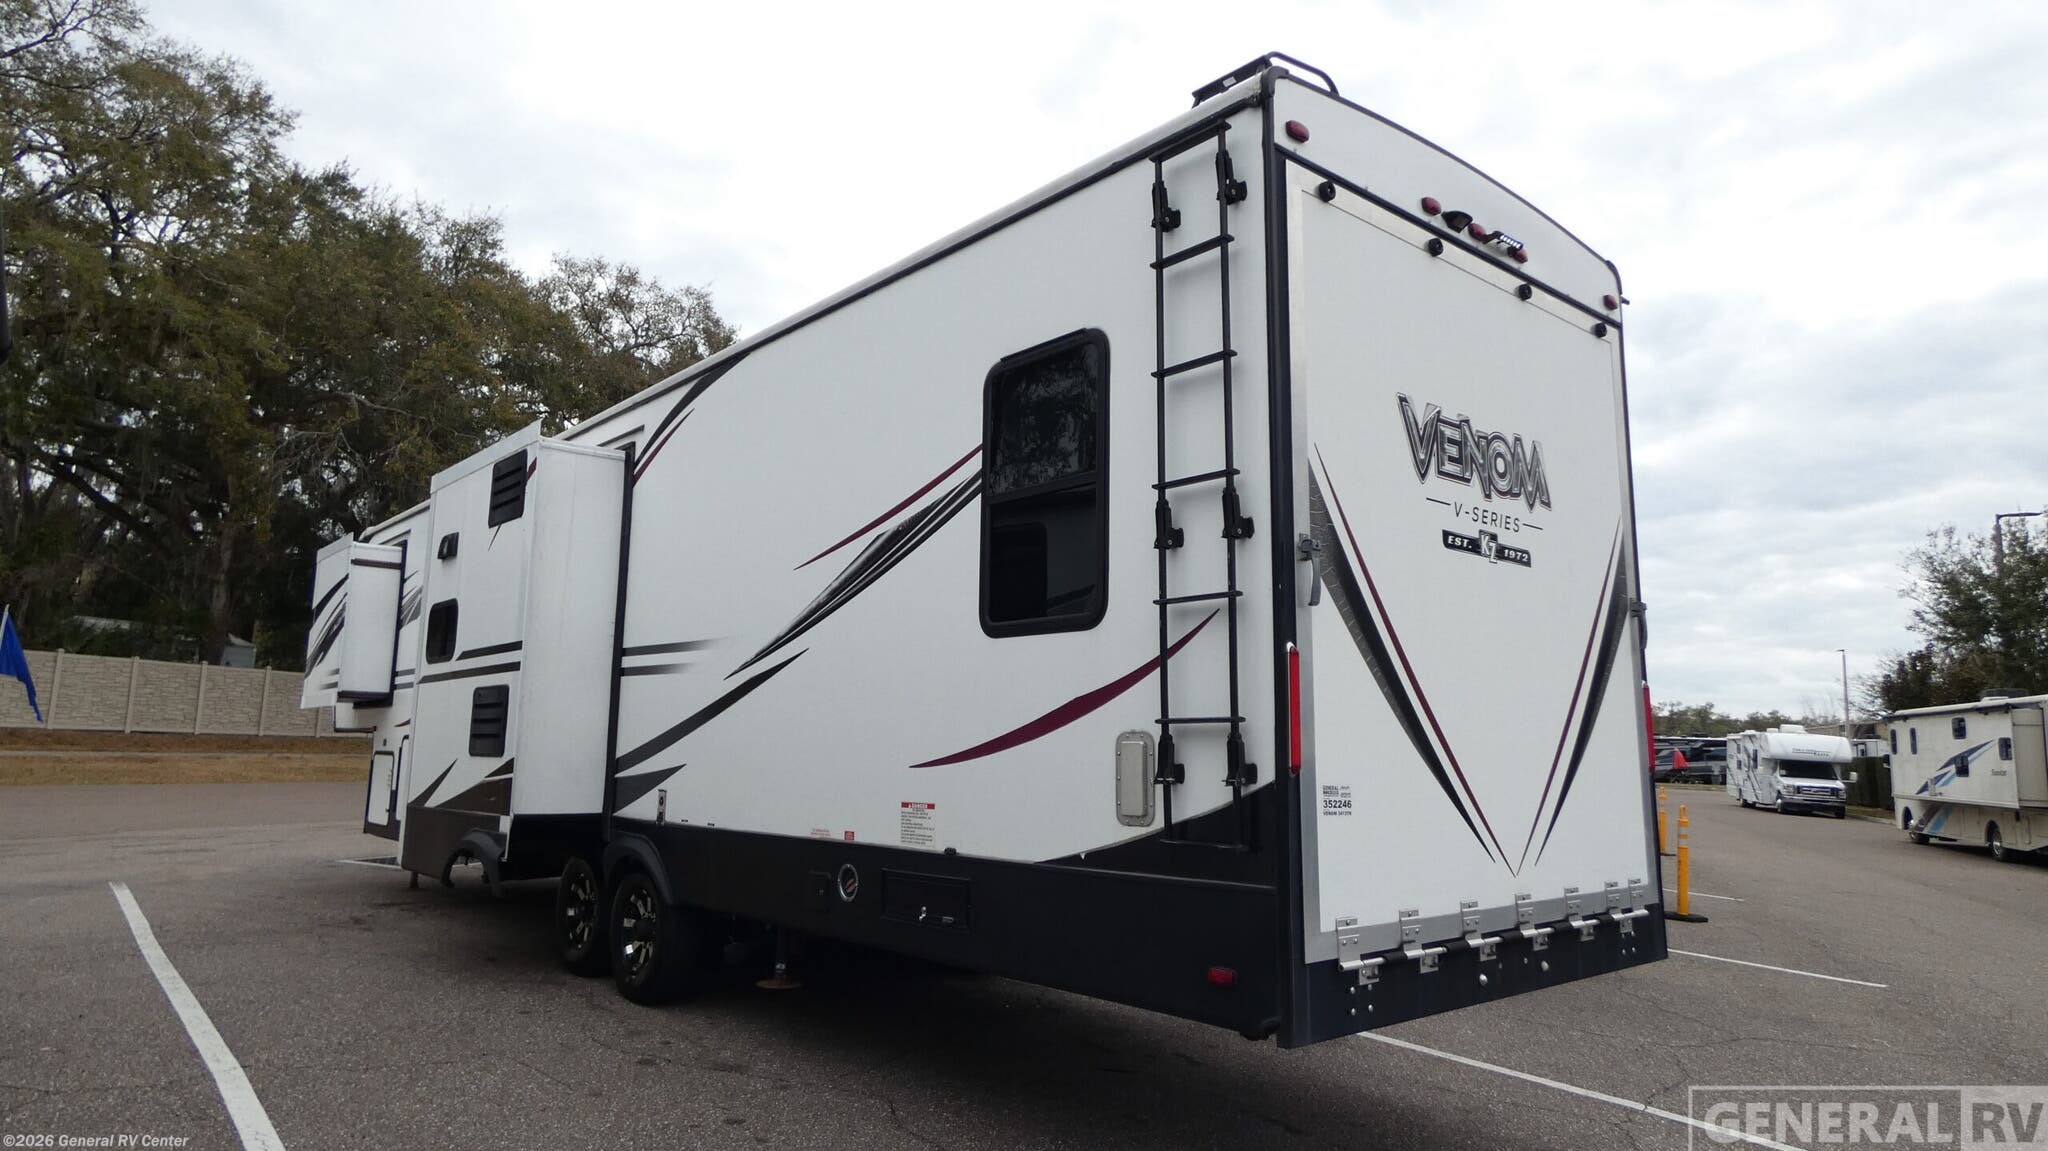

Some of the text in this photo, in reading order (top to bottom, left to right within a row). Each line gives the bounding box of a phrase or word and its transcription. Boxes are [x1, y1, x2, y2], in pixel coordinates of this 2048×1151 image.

[1396, 392, 1552, 513] VENOM
[1454, 502, 1520, 533] V-SERIES
[1447, 535, 1472, 549] EST.
[1503, 549, 1529, 562] 1972
[1323, 800, 1352, 808] 352246
